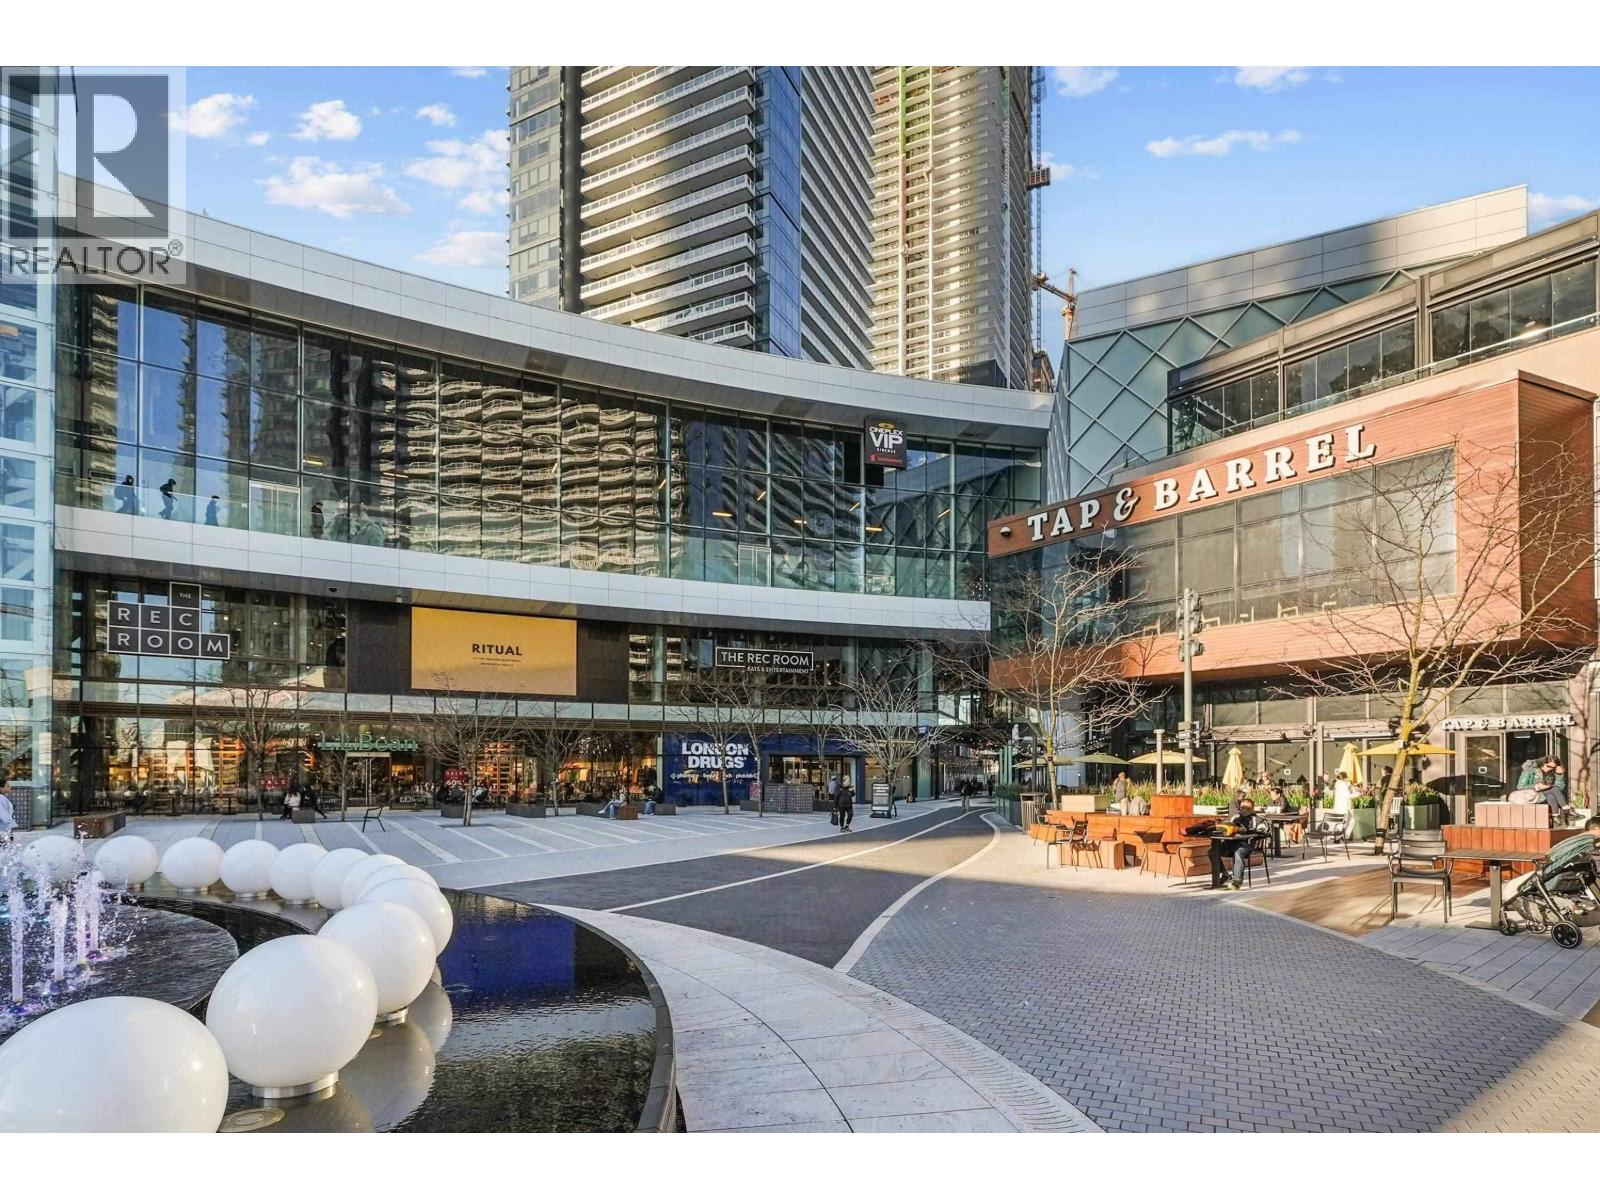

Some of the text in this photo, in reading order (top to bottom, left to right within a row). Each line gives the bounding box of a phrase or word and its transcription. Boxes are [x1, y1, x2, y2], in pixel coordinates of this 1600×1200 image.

[869, 432, 903, 449] VIP
[1027, 424, 1376, 542] TAP & BARREL
[179, 592, 192, 600] THE
[117, 607, 193, 627] REC
[117, 632, 223, 653] ROOM
[472, 643, 523, 656] RITUAL
[721, 651, 809, 666] THE REC ROOM
